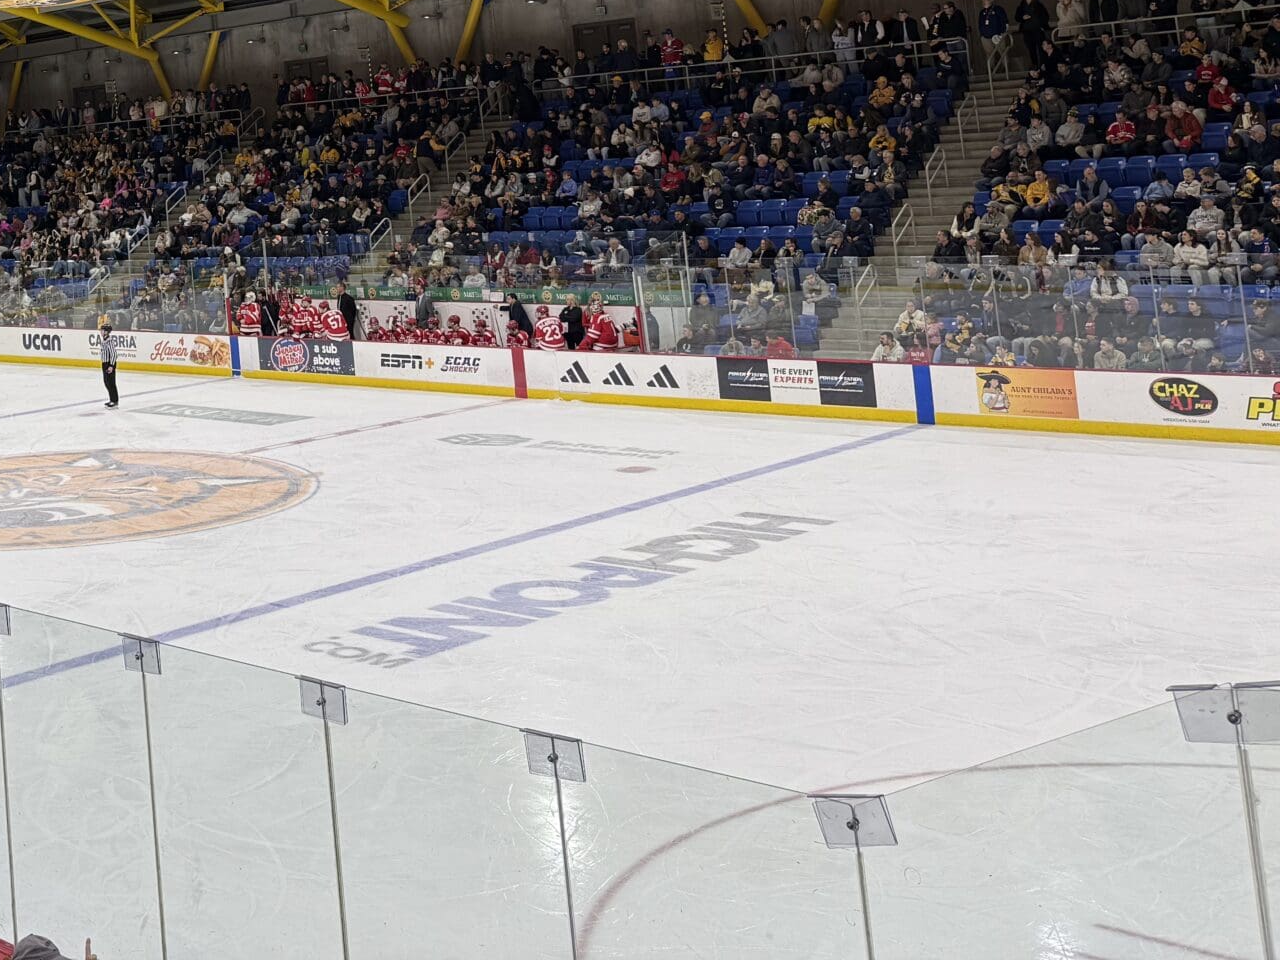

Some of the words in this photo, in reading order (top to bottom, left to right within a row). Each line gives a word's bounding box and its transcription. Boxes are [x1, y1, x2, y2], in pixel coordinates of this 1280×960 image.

[327, 315, 342, 330] 57
[543, 324, 561, 341] 23
[22, 333, 61, 351] ucan
[88, 334, 136, 349] CABRiA
[313, 345, 320, 353] a
[322, 343, 338, 354] sub
[150, 340, 189, 362] Haven
[275, 343, 303, 357] Jersey
[313, 355, 341, 366] above
[380, 353, 435, 370] ESPN+
[445, 356, 481, 367] ECAC
[448, 365, 479, 374] HOCKEY
[772, 367, 787, 375] THE
[788, 368, 814, 376] EVENT
[774, 375, 814, 385] EXPERTS
[1010, 386, 1032, 394] AUNT
[1032, 387, 1073, 396] CHILADA'S
[1152, 381, 1200, 398] CHAZ
[1170, 396, 1193, 412] AJ
[351, 511, 838, 659] HIGHPOINT
